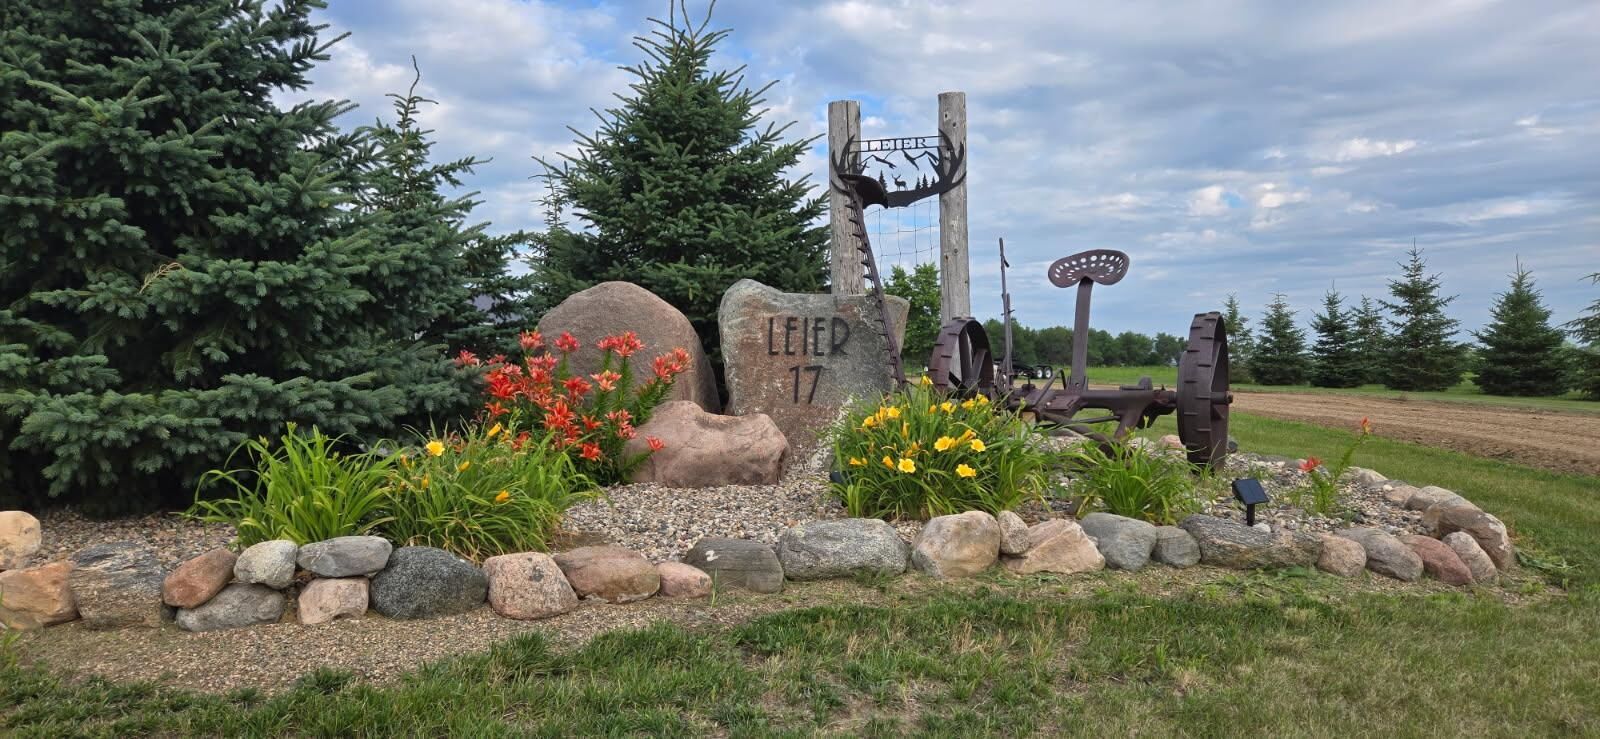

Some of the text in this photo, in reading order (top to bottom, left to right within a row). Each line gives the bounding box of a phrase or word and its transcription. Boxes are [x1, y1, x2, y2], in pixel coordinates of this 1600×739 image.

[866, 136, 928, 152] LEIER
[768, 316, 850, 356] LEIER
[789, 365, 824, 404] 17
